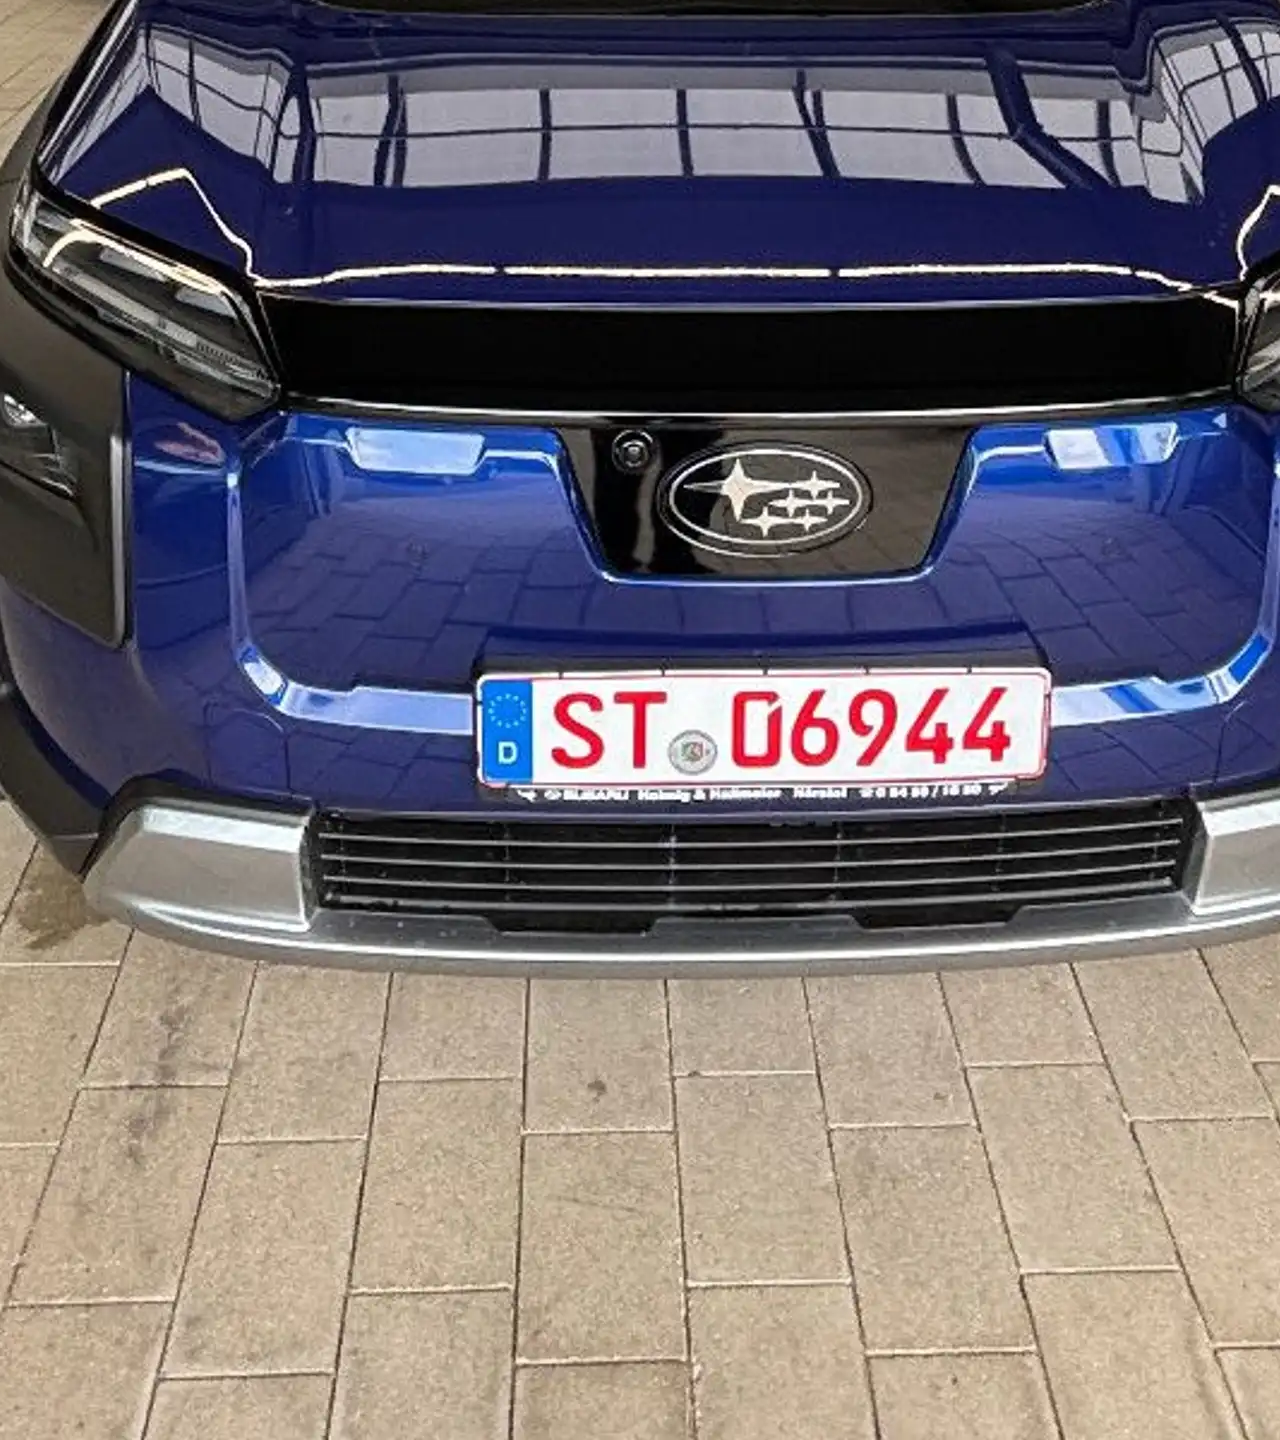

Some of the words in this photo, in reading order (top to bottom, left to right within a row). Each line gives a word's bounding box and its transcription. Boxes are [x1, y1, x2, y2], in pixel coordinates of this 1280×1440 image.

[498, 741, 518, 765] D
[551, 691, 667, 769] ST
[732, 687, 1011, 767] 06944
